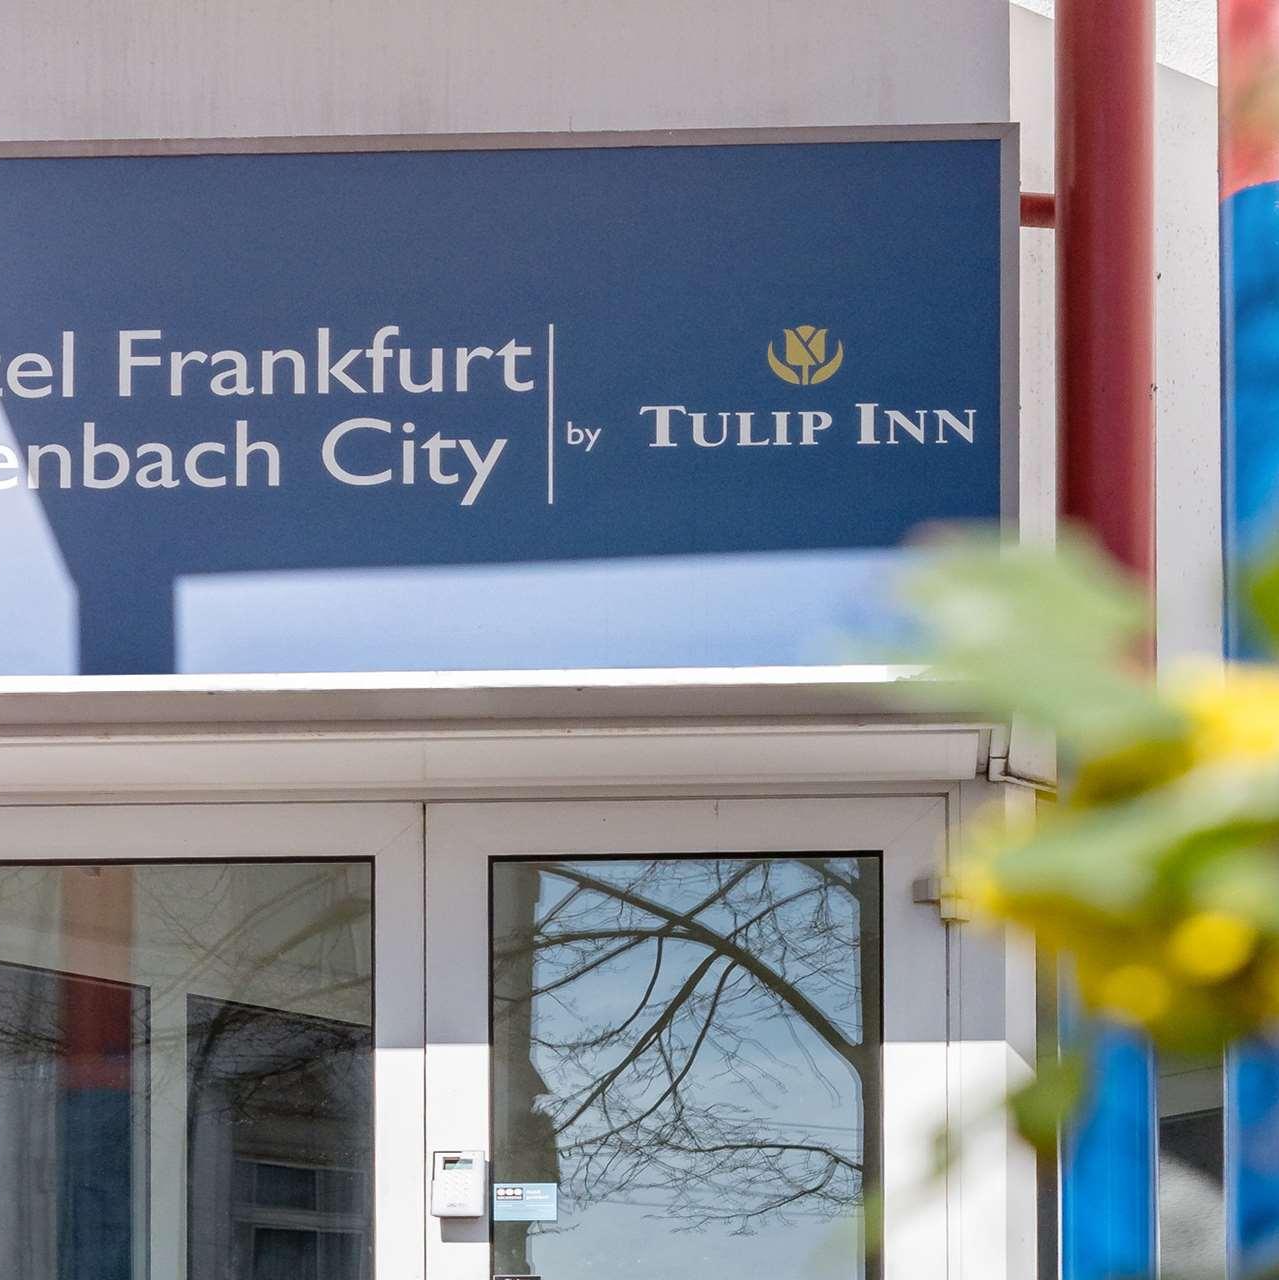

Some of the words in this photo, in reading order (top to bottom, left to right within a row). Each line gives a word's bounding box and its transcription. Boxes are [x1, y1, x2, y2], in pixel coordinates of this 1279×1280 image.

[118, 325, 535, 397] Frankfurt
[566, 421, 602, 452] by
[639, 404, 833, 448] TULIP
[854, 403, 977, 445] INN
[320, 416, 509, 506] City
